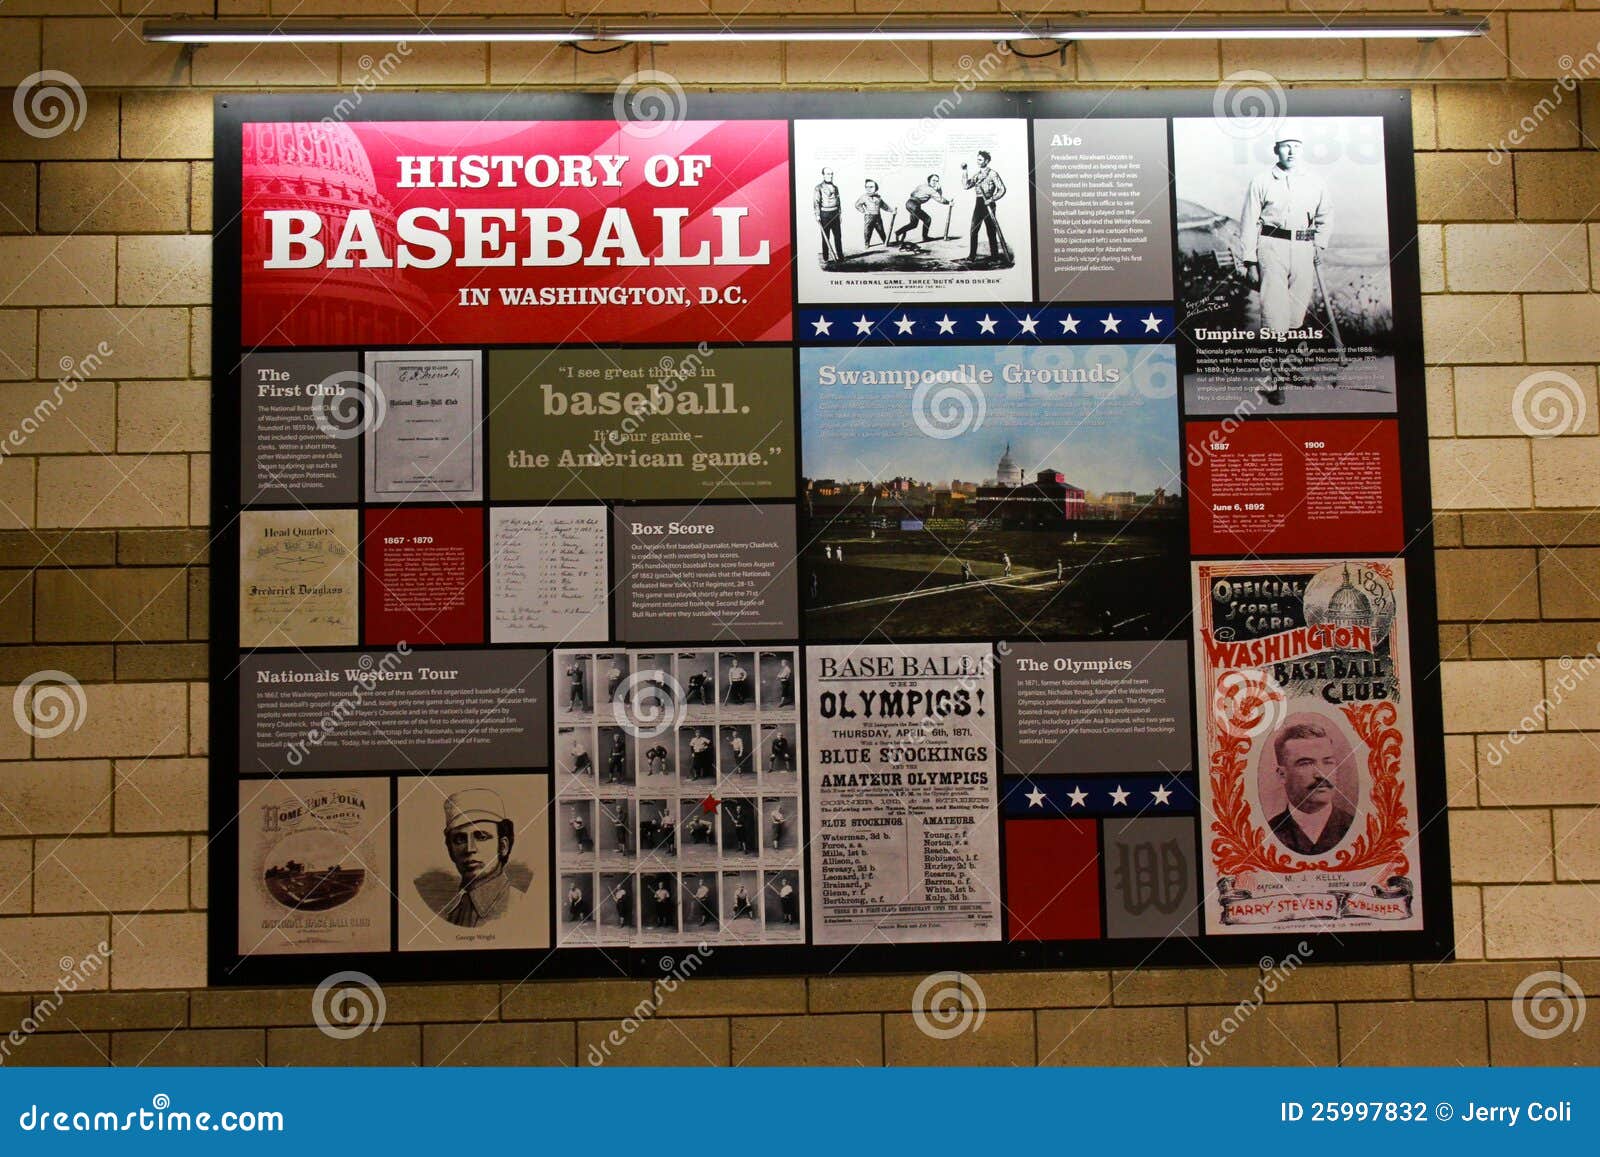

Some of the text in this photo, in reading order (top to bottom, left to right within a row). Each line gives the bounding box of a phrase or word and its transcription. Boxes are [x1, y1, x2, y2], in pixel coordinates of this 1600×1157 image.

[1050, 134, 1082, 146] Abe
[396, 154, 711, 188] HISTORY OF
[263, 206, 770, 270] BASEBALL
[458, 286, 748, 309] IN WASHINGTON, D.C.
[1194, 327, 1323, 343] Umpire Signals
[258, 369, 291, 381] The
[577, 369, 600, 378] see
[605, 368, 644, 380] great
[649, 366, 697, 380] things
[701, 366, 716, 377] in
[818, 363, 1120, 390] Swampoodle Grounds
[258, 383, 346, 397] First Club
[540, 383, 750, 416] baseball.
[622, 432, 647, 441] our
[652, 431, 692, 444] game
[1304, 441, 1325, 449] 1900
[508, 450, 550, 468] the
[558, 449, 684, 468] American
[1234, 504, 1243, 512] 6,
[1245, 503, 1265, 511] 1892
[264, 528, 290, 538] Head
[631, 521, 715, 535] Box Score
[412, 536, 433, 544] 1870
[250, 584, 343, 597] Frederick Douglass
[1213, 580, 1304, 602] OFFICIAL
[1245, 615, 1295, 633] CARD
[1201, 623, 1374, 668] WASHINGTON
[819, 656, 894, 677] BASE
[1017, 657, 1132, 674] The Olympics
[1274, 656, 1385, 687] BASE BALL
[257, 668, 458, 683] Nationals Western Tour
[1321, 682, 1388, 704] CLUB
[820, 689, 985, 719] OLYMPICS!
[832, 730, 891, 740] THURSDAY,
[932, 729, 948, 738] 6th,
[820, 747, 988, 764] BLUE STOCKINGS
[821, 772, 988, 787] AMATEUR OLYMPICS
[821, 817, 903, 828] BLUE STOCKINGS
[1228, 903, 1272, 917] HARRY
[1278, 898, 1332, 913] STEVENS
[456, 934, 475, 942] George
